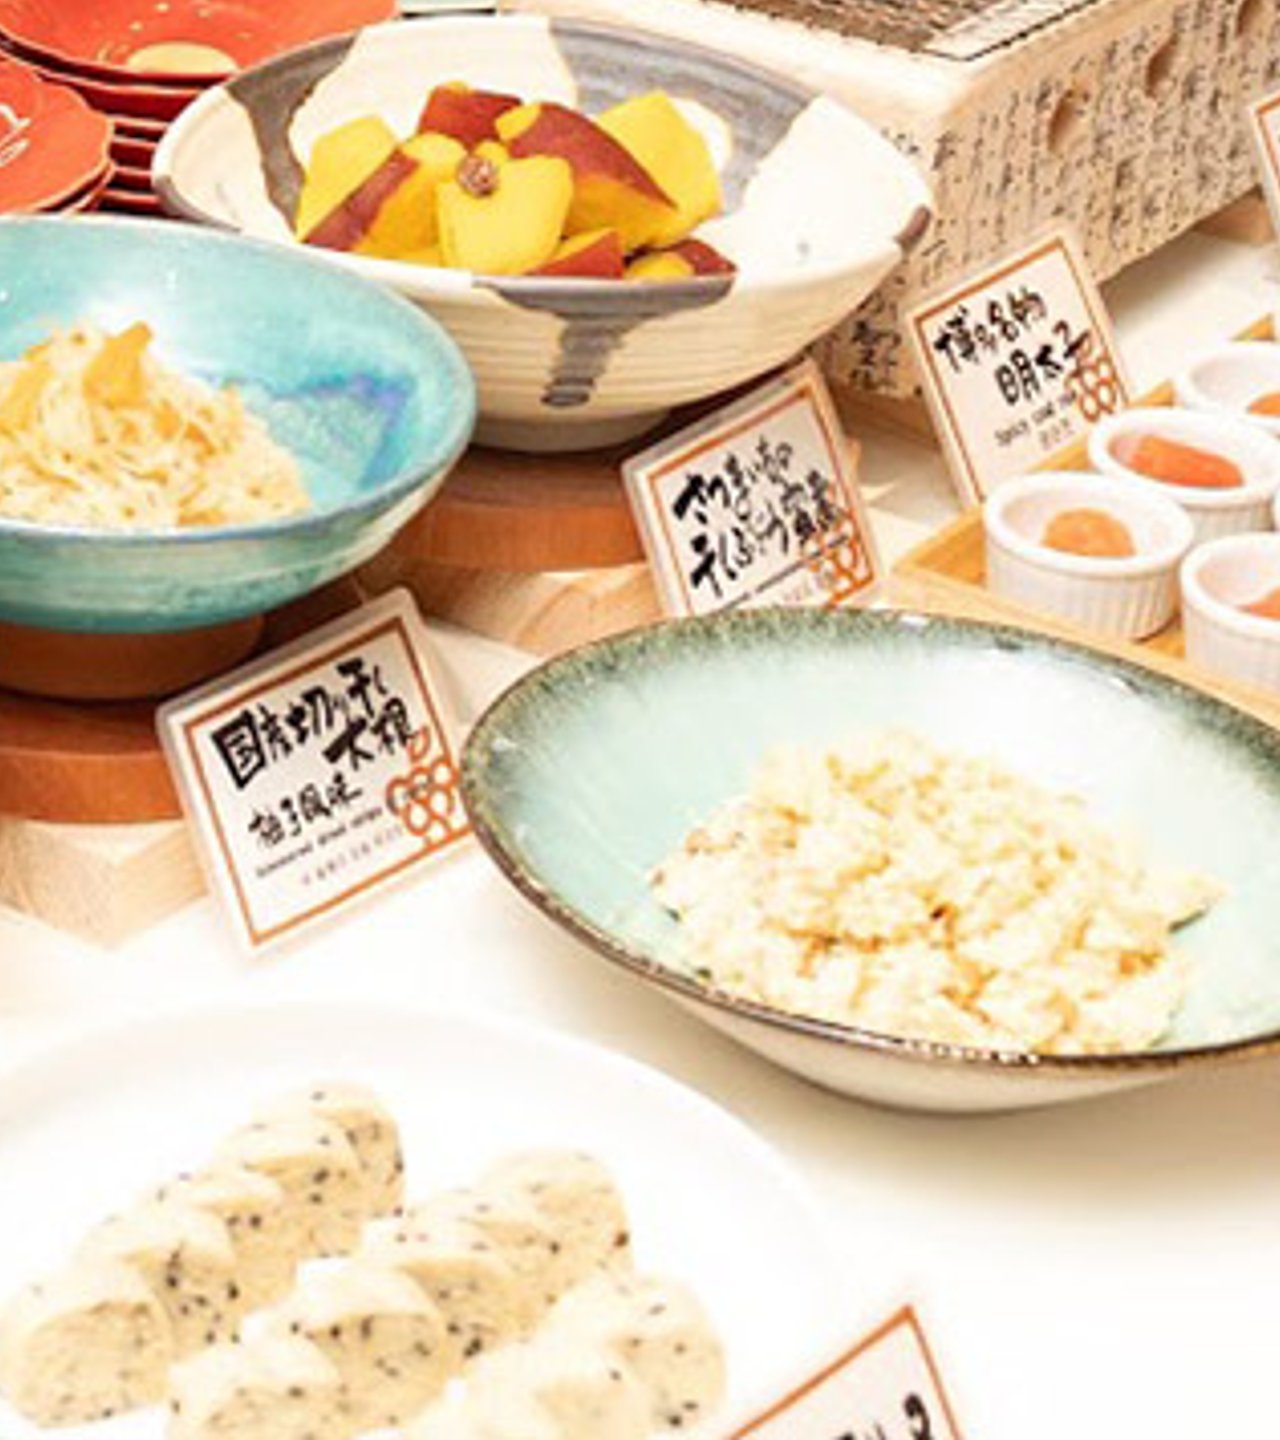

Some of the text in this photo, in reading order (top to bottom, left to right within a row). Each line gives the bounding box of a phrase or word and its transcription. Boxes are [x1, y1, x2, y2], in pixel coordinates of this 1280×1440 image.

[324, 697, 419, 771] 大根
[248, 772, 364, 848] 柚子風味
